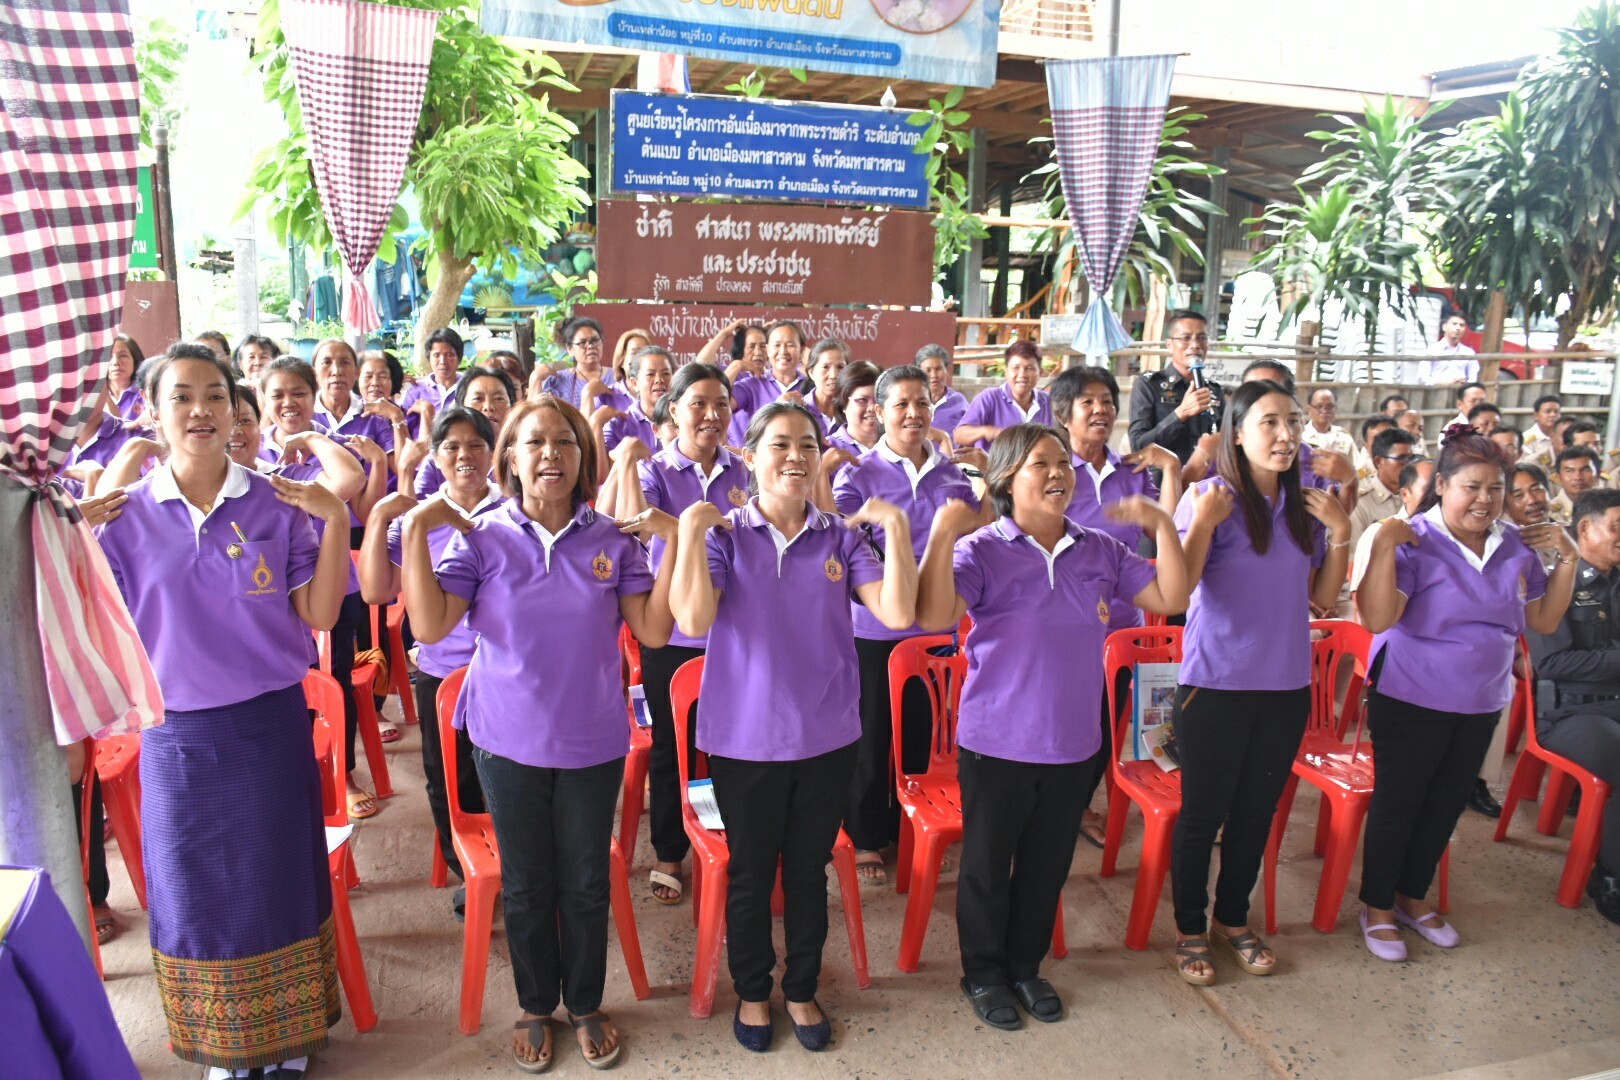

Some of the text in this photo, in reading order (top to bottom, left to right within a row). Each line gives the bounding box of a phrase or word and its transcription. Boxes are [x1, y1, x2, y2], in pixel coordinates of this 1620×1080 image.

[641, 137, 906, 173] ต้นแบบ อำเภอเมืองมหาสารคาม จังหวัดมหาสารคาม
[624, 170, 690, 186] บ้านเหล่าน้อย
[725, 173, 774, 190] ตำบลเขวา
[778, 176, 830, 194] อำเภอเมือง
[831, 180, 918, 198] จังหวัดมหาสารคาม
[695, 212, 752, 241] ศาสนา
[703, 247, 812, 277] และ ประชาชน
